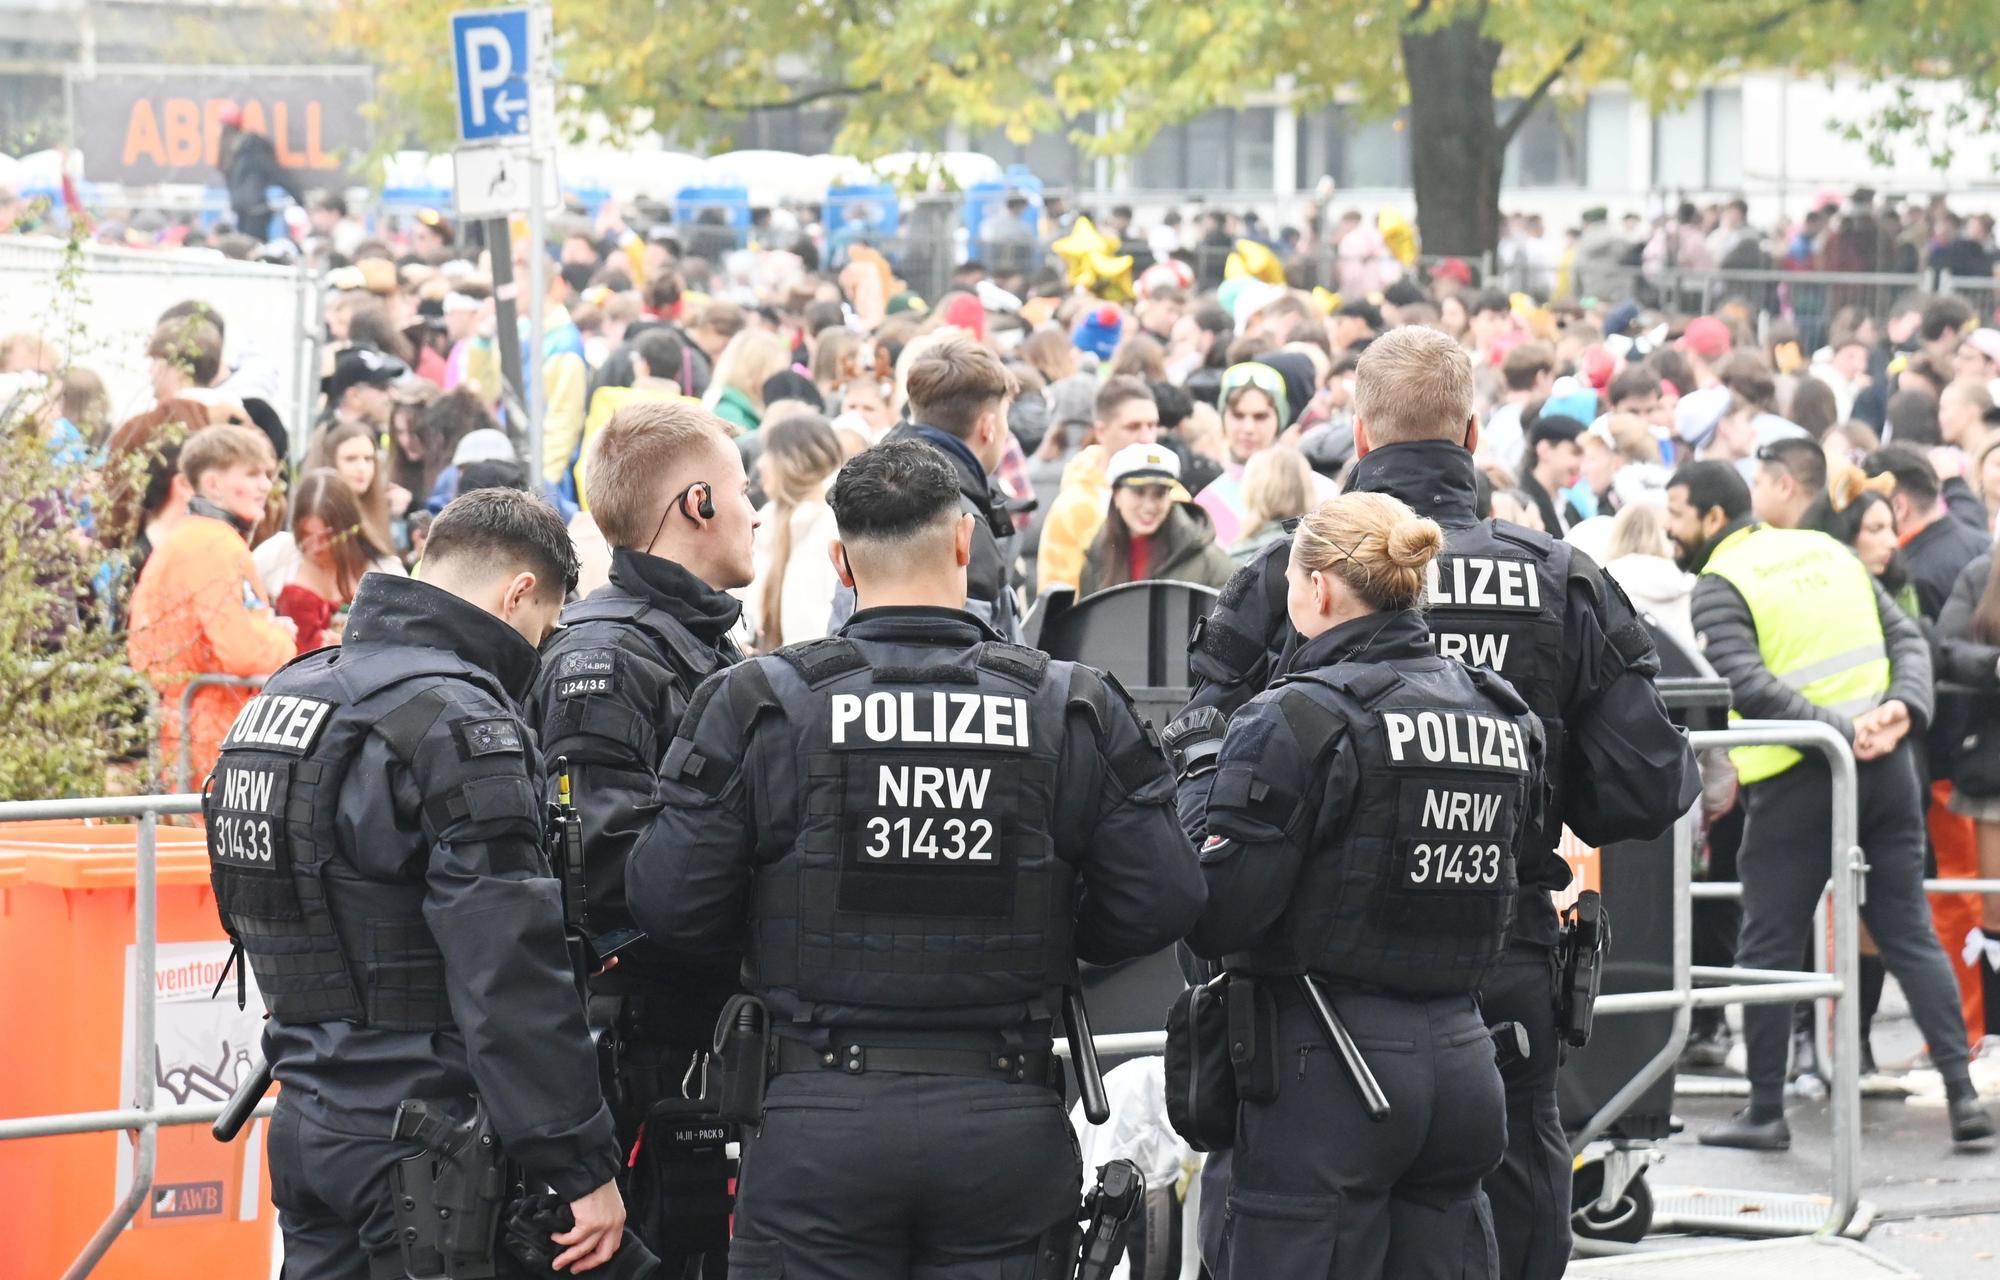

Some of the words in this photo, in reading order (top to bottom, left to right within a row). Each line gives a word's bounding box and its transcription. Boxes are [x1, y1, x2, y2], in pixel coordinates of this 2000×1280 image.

[464, 27, 513, 126] P
[1426, 558, 1541, 608] LIZEI
[1428, 632, 1510, 672] RW
[561, 679, 606, 695] J24/35
[222, 695, 330, 750] OLIZEI
[831, 691, 1030, 747] POLIZEI
[1383, 711, 1530, 771] POLIZEI
[222, 767, 275, 813] NRW
[878, 765, 992, 810] NRW
[1421, 788, 1503, 833] NRW
[215, 815, 273, 862] 31433
[865, 816, 993, 860] 31432
[1410, 843, 1501, 885] 31433
[699, 1129, 717, 1140] PACK
[718, 1128, 724, 1138] 9
[178, 1186, 218, 1211] AWB
